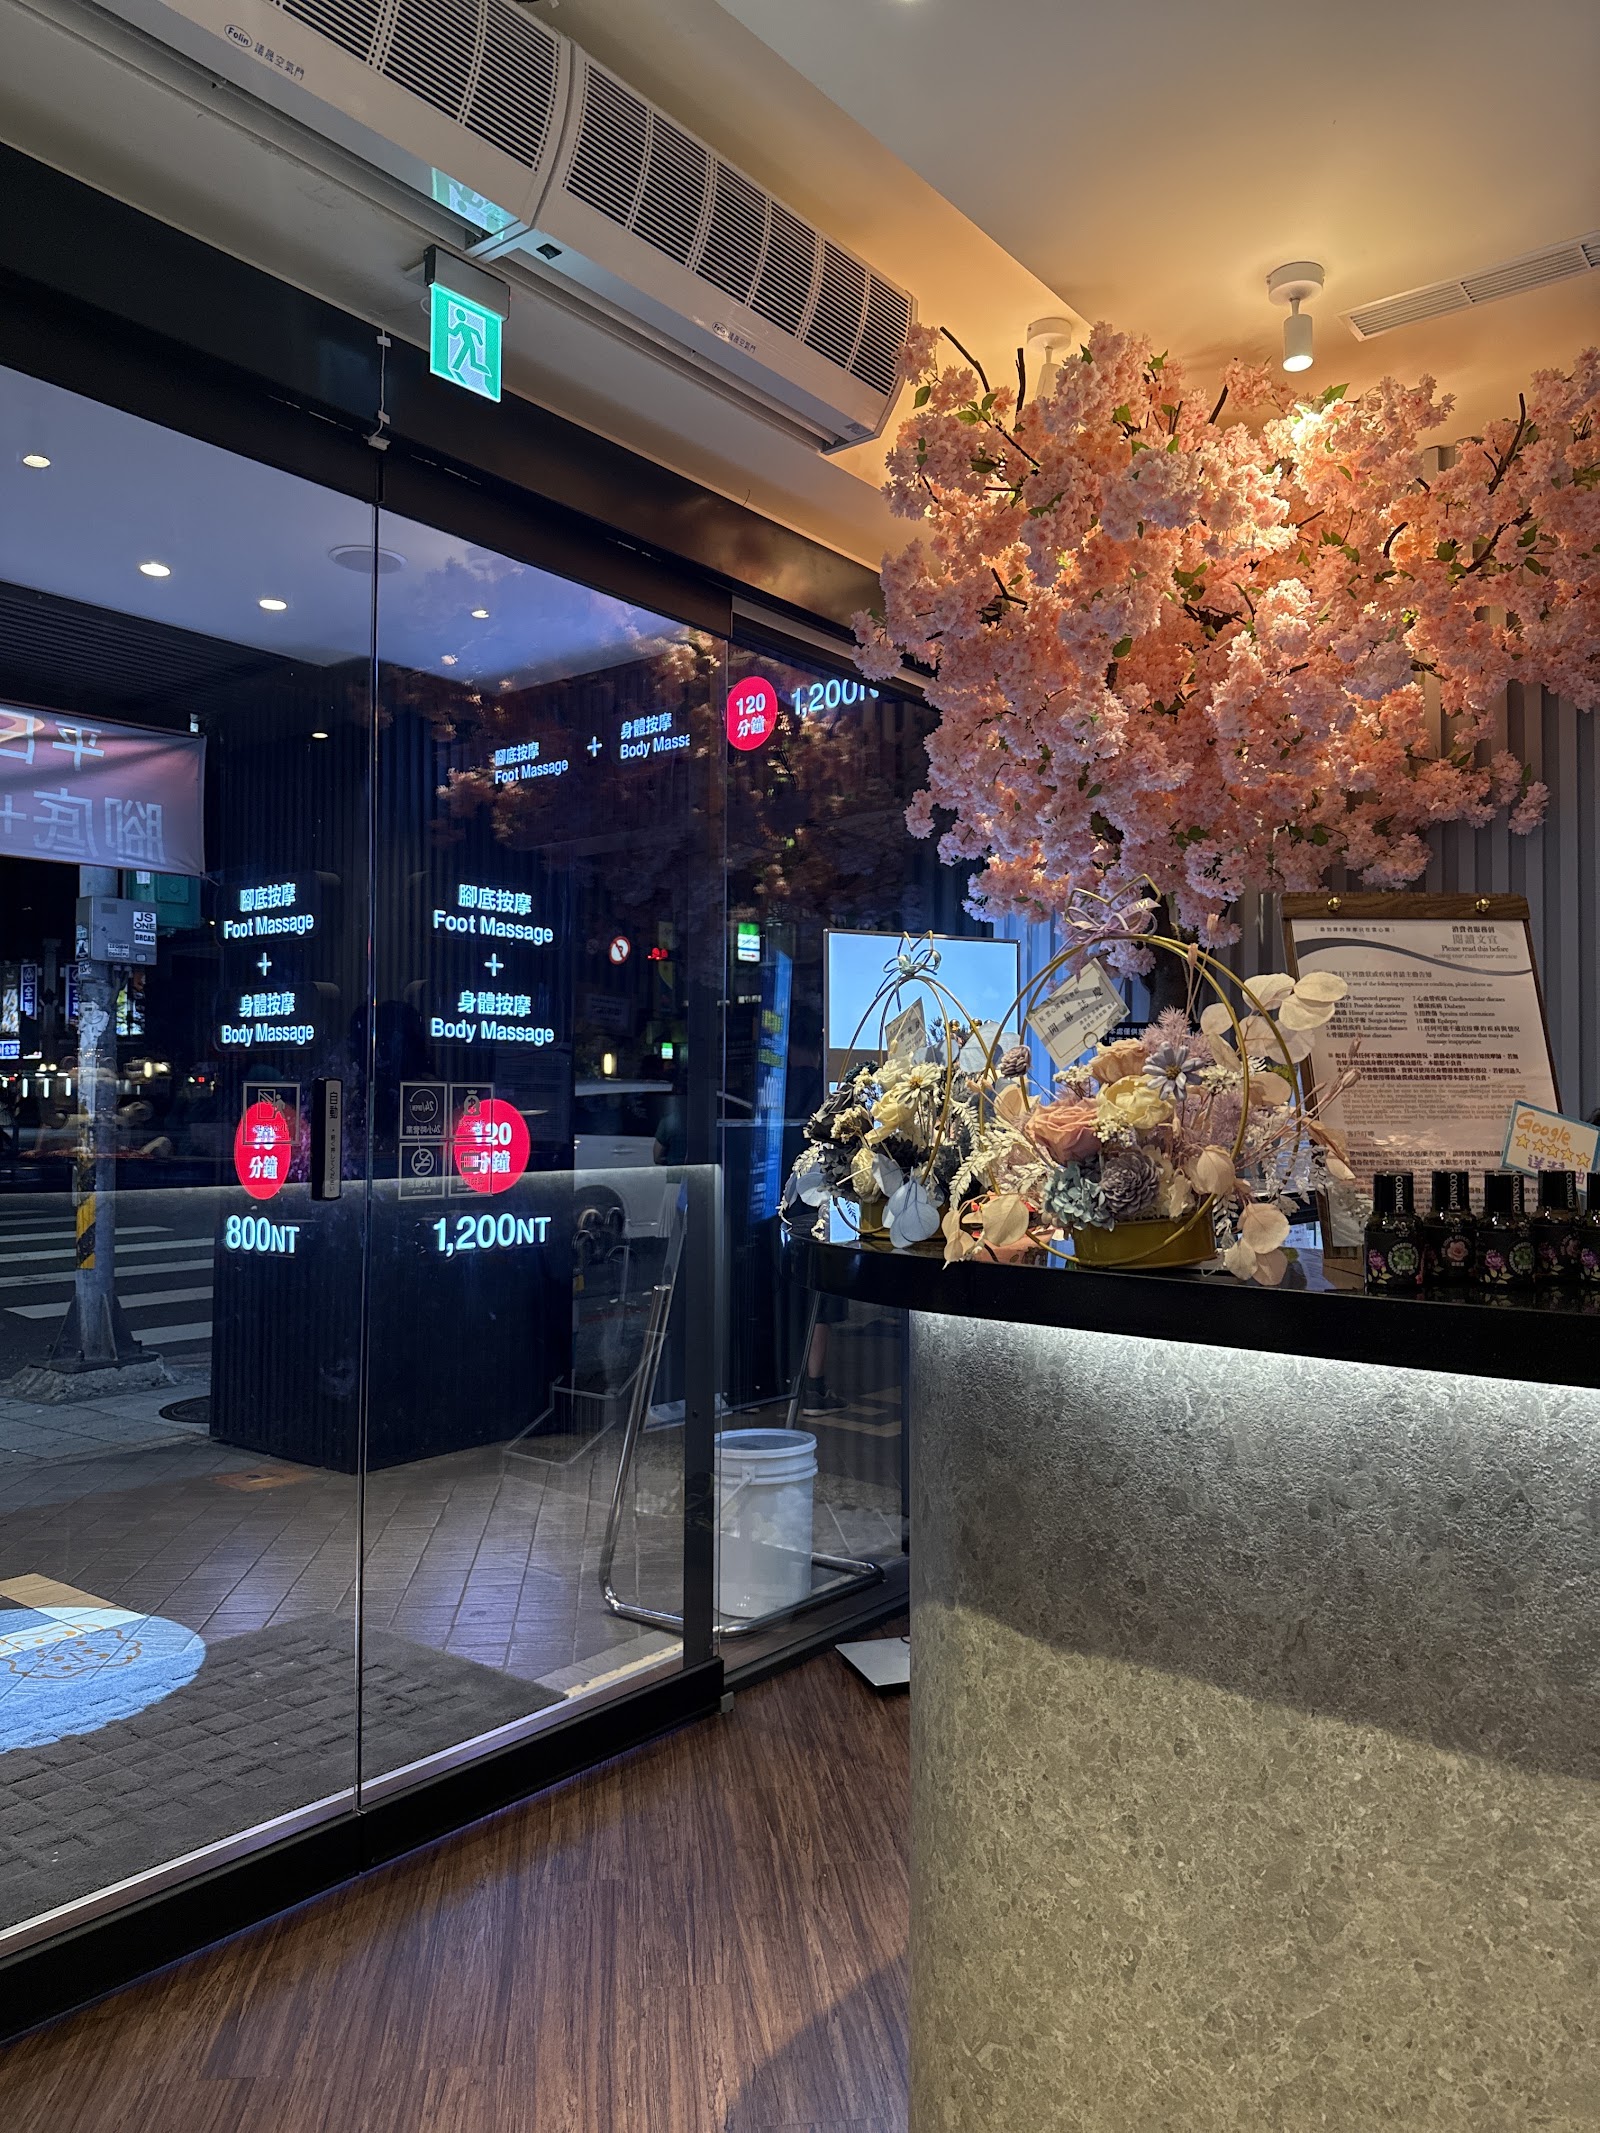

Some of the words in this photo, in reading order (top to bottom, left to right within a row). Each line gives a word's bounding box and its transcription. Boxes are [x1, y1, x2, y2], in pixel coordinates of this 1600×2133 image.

[228, 27, 249, 46] Folin
[736, 692, 766, 716] 120
[620, 711, 672, 740] 身體按摩
[737, 714, 765, 738] 分鐘
[494, 741, 540, 766] 腳底按摩
[619, 742, 650, 760] Body
[494, 767, 520, 785] Foot
[521, 758, 569, 779] Massage
[239, 882, 297, 913] 腳底按摩
[458, 883, 532, 916] 腳底按摩
[134, 922, 155, 930] ONE
[136, 912, 153, 923] JS
[223, 917, 254, 940] Foot
[255, 914, 314, 937] Massage
[432, 910, 476, 934] Foot
[479, 914, 554, 946] Massage
[1489, 945, 1509, 953] before
[238, 992, 295, 1018] 身體按摩
[457, 991, 532, 1018] 身體按摩
[221, 1023, 253, 1047] Body
[255, 1022, 314, 1045] Massage
[430, 1018, 477, 1043] Body
[480, 1020, 555, 1047] Massage
[1516, 1111, 1571, 1146] Google
[249, 1155, 278, 1179] 分鐘
[1395, 1175, 1404, 1213] COSMIC
[1449, 1173, 1458, 1209] COSMIC
[1512, 1175, 1521, 1213] COSMIC
[1566, 1172, 1575, 1209] COSMIC
[226, 1214, 300, 1254] 800NT
[433, 1213, 551, 1257] 1,200NT
